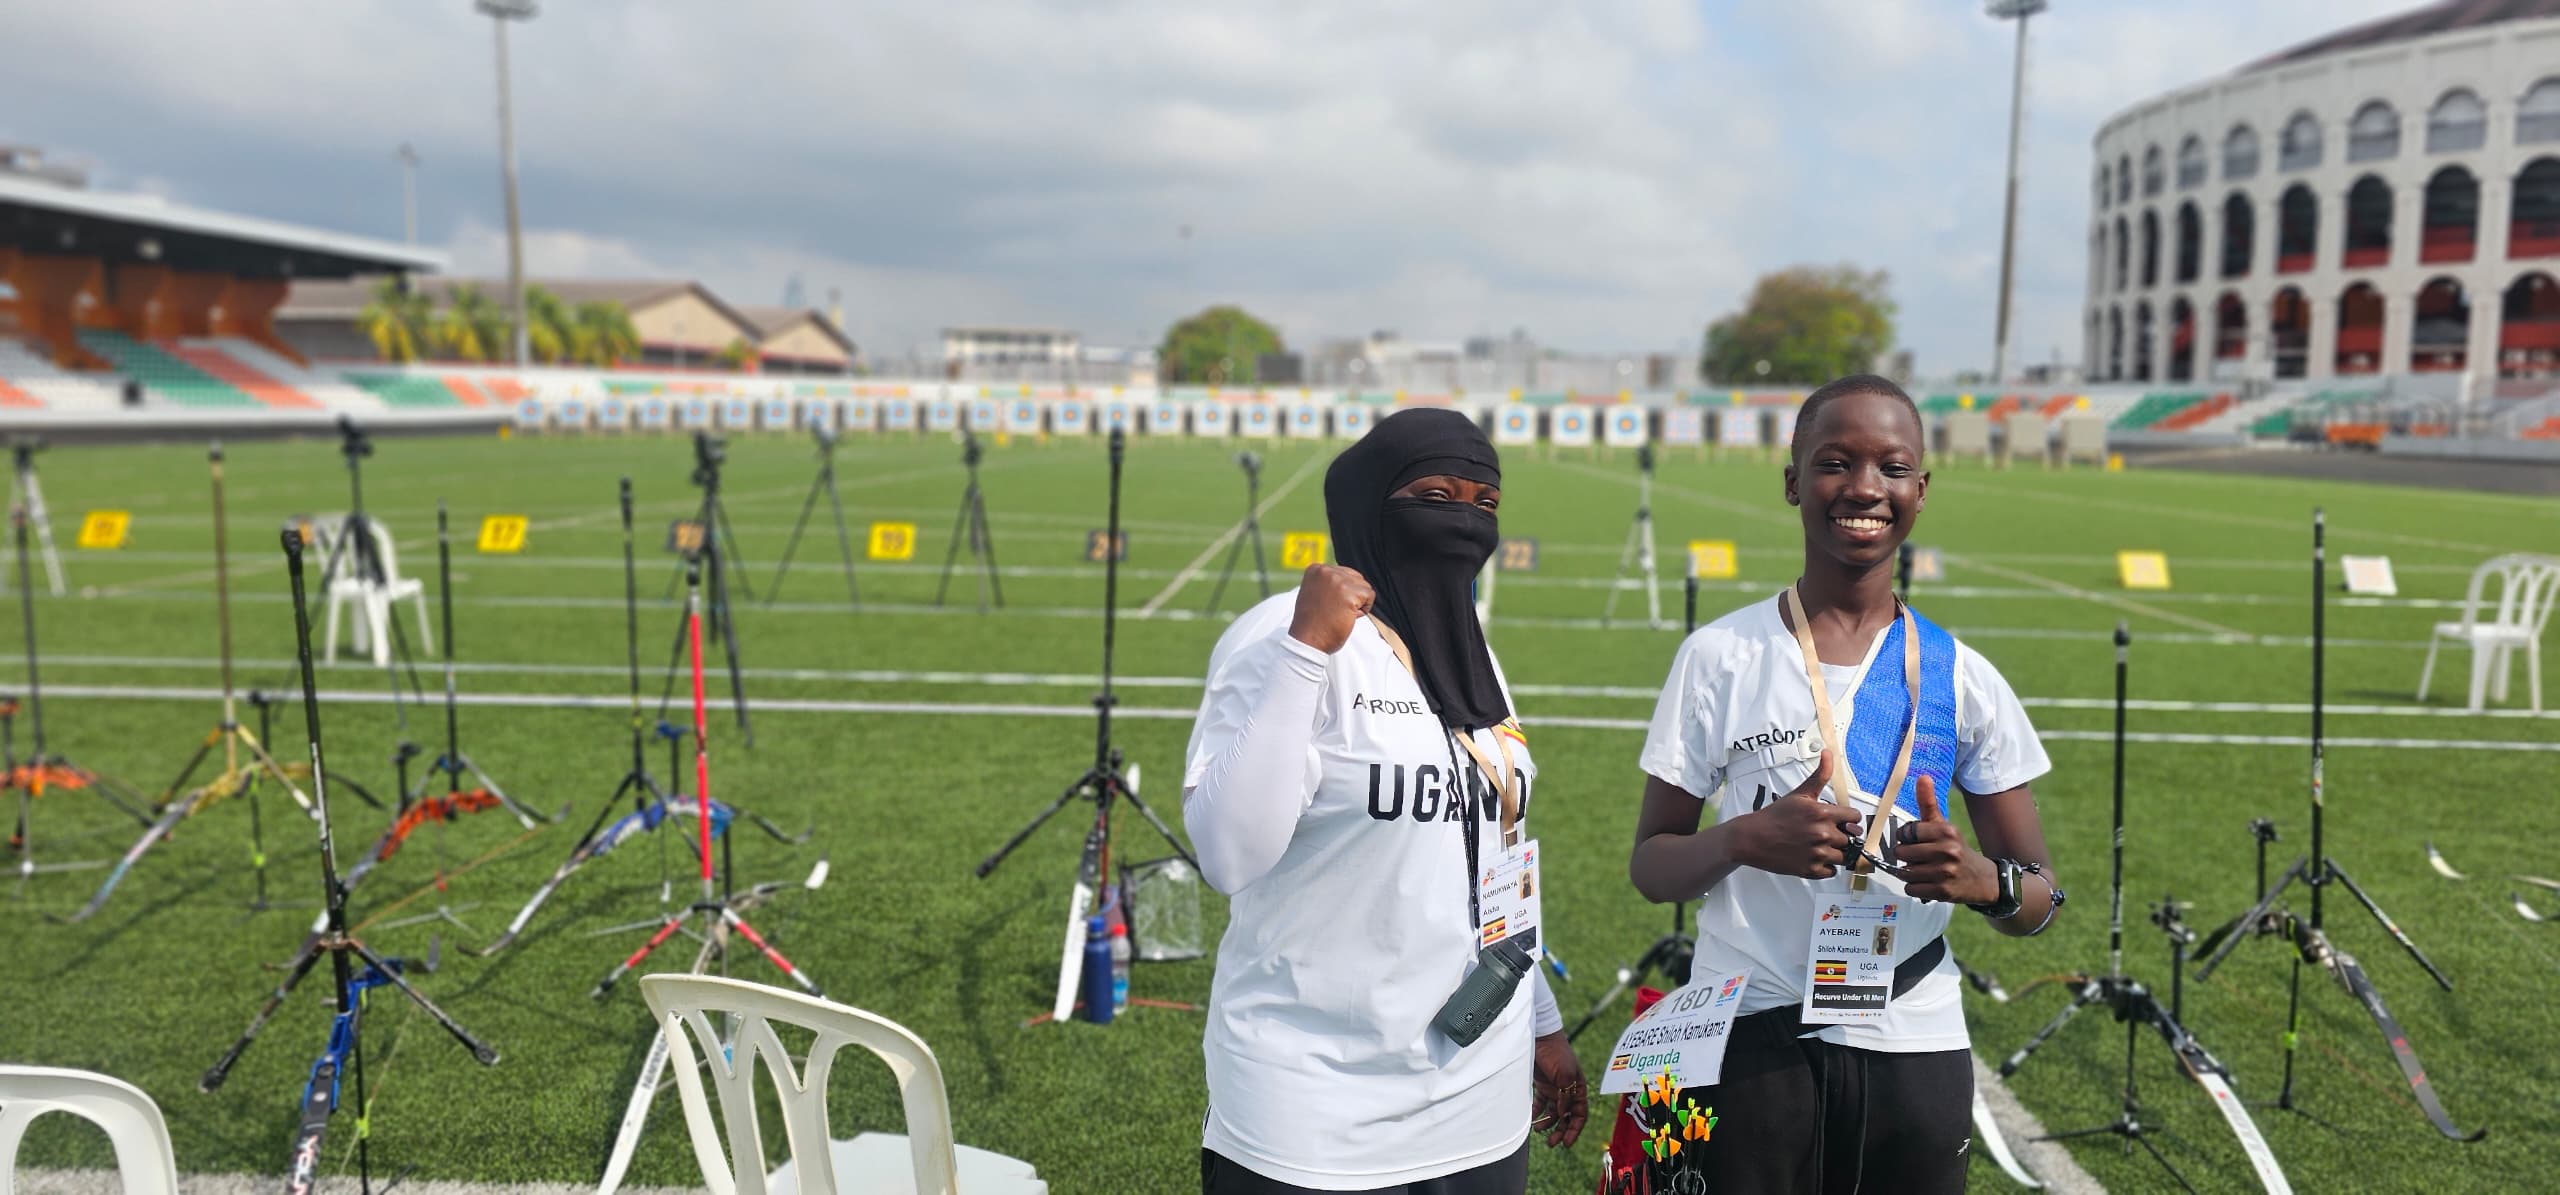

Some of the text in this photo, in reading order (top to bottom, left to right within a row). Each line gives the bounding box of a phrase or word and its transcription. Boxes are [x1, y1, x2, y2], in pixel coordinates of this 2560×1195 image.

[1367, 763, 1528, 823] UGAND
[1819, 928, 1861, 937] AYEBARE
[1817, 944, 1836, 953] Shiloh
[1859, 962, 1879, 971] UGA
[1671, 986, 1714, 1014] 18D
[1814, 993, 1842, 1001] Recurve
[1842, 993, 1861, 1001] Under
[1628, 1049, 1681, 1072] Uganda
